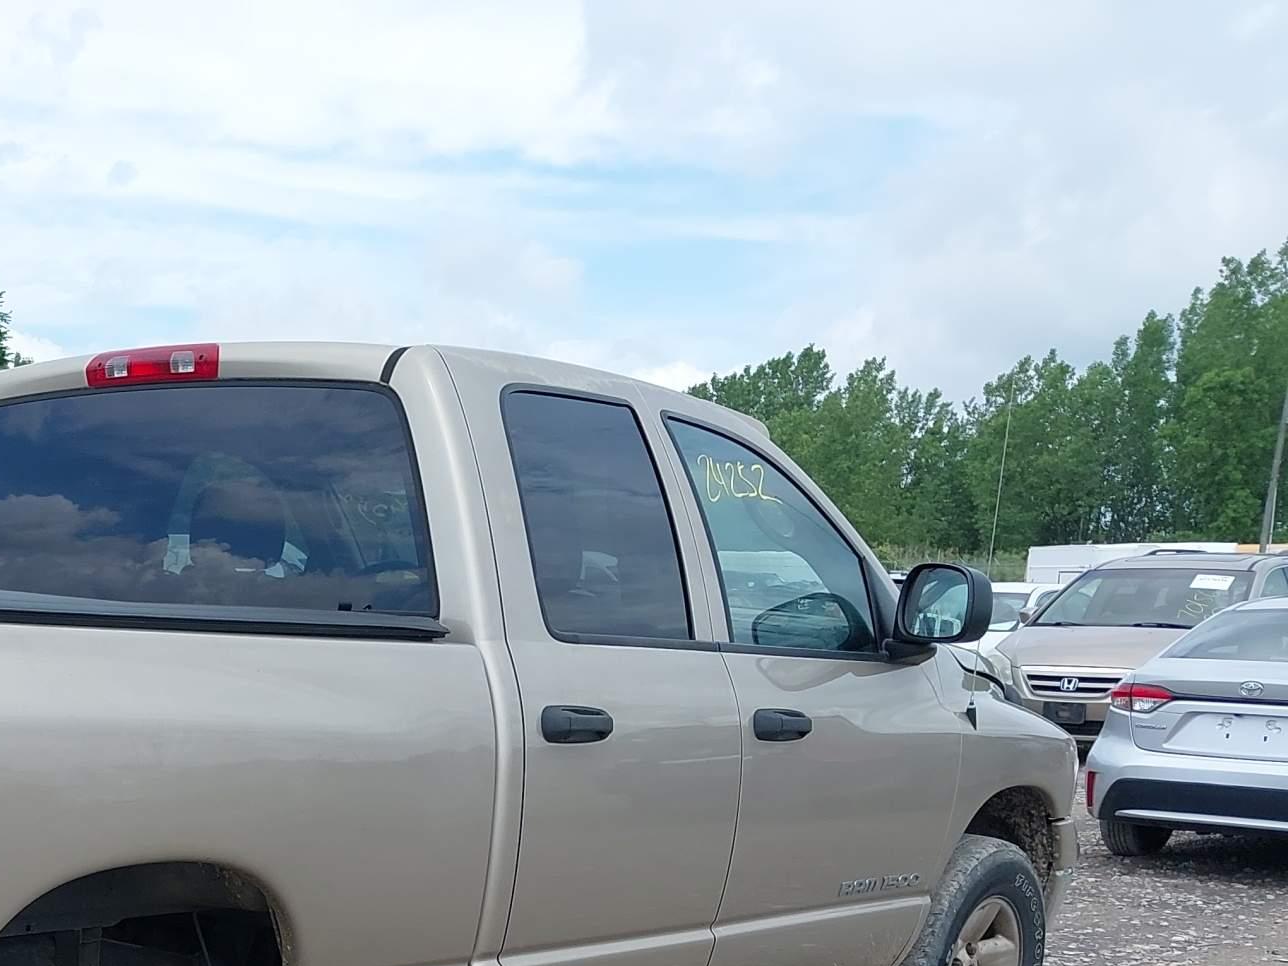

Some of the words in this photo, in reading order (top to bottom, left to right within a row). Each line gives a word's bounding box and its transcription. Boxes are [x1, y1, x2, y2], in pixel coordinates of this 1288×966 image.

[697, 454, 783, 504] 24252
[838, 878, 879, 897] RAM
[880, 872, 920, 890] 1500
